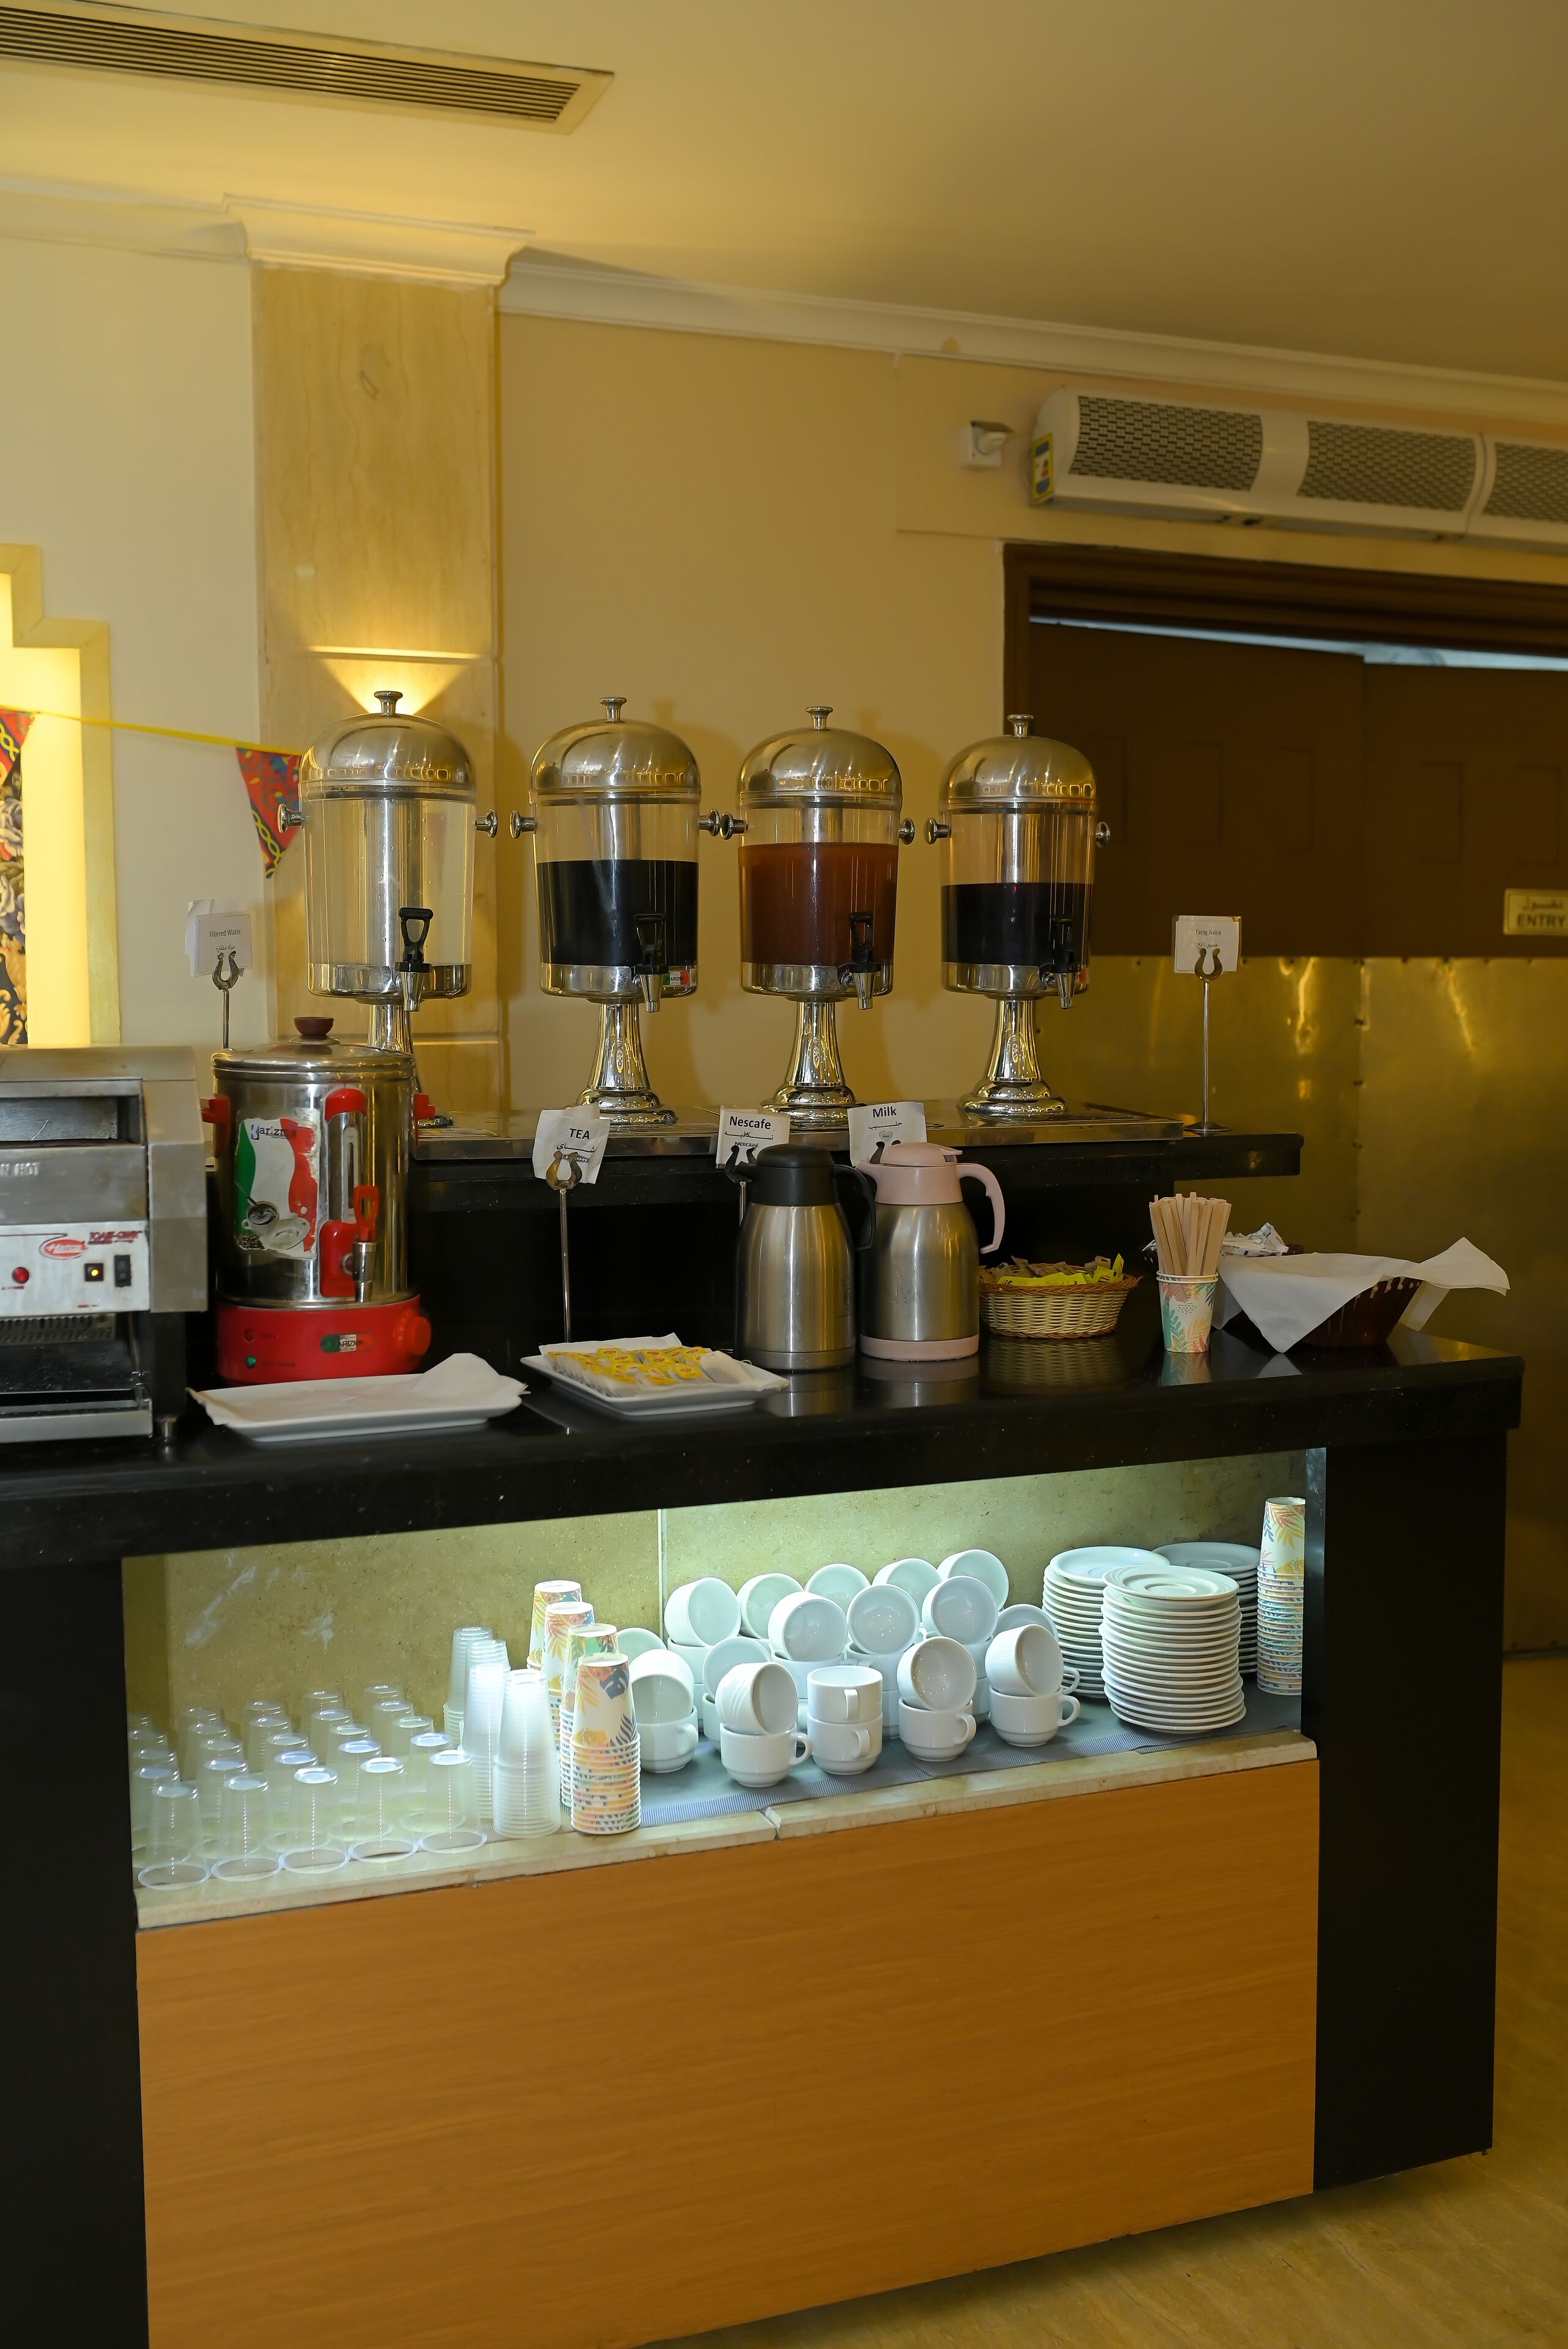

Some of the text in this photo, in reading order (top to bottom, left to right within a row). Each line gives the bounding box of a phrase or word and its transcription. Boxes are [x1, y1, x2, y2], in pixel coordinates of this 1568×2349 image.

[1517, 914, 1567, 927] ENTRY
[872, 1106, 897, 1118] Milk
[729, 1116, 771, 1129] Nescafe
[570, 1128, 590, 1140] TEA
